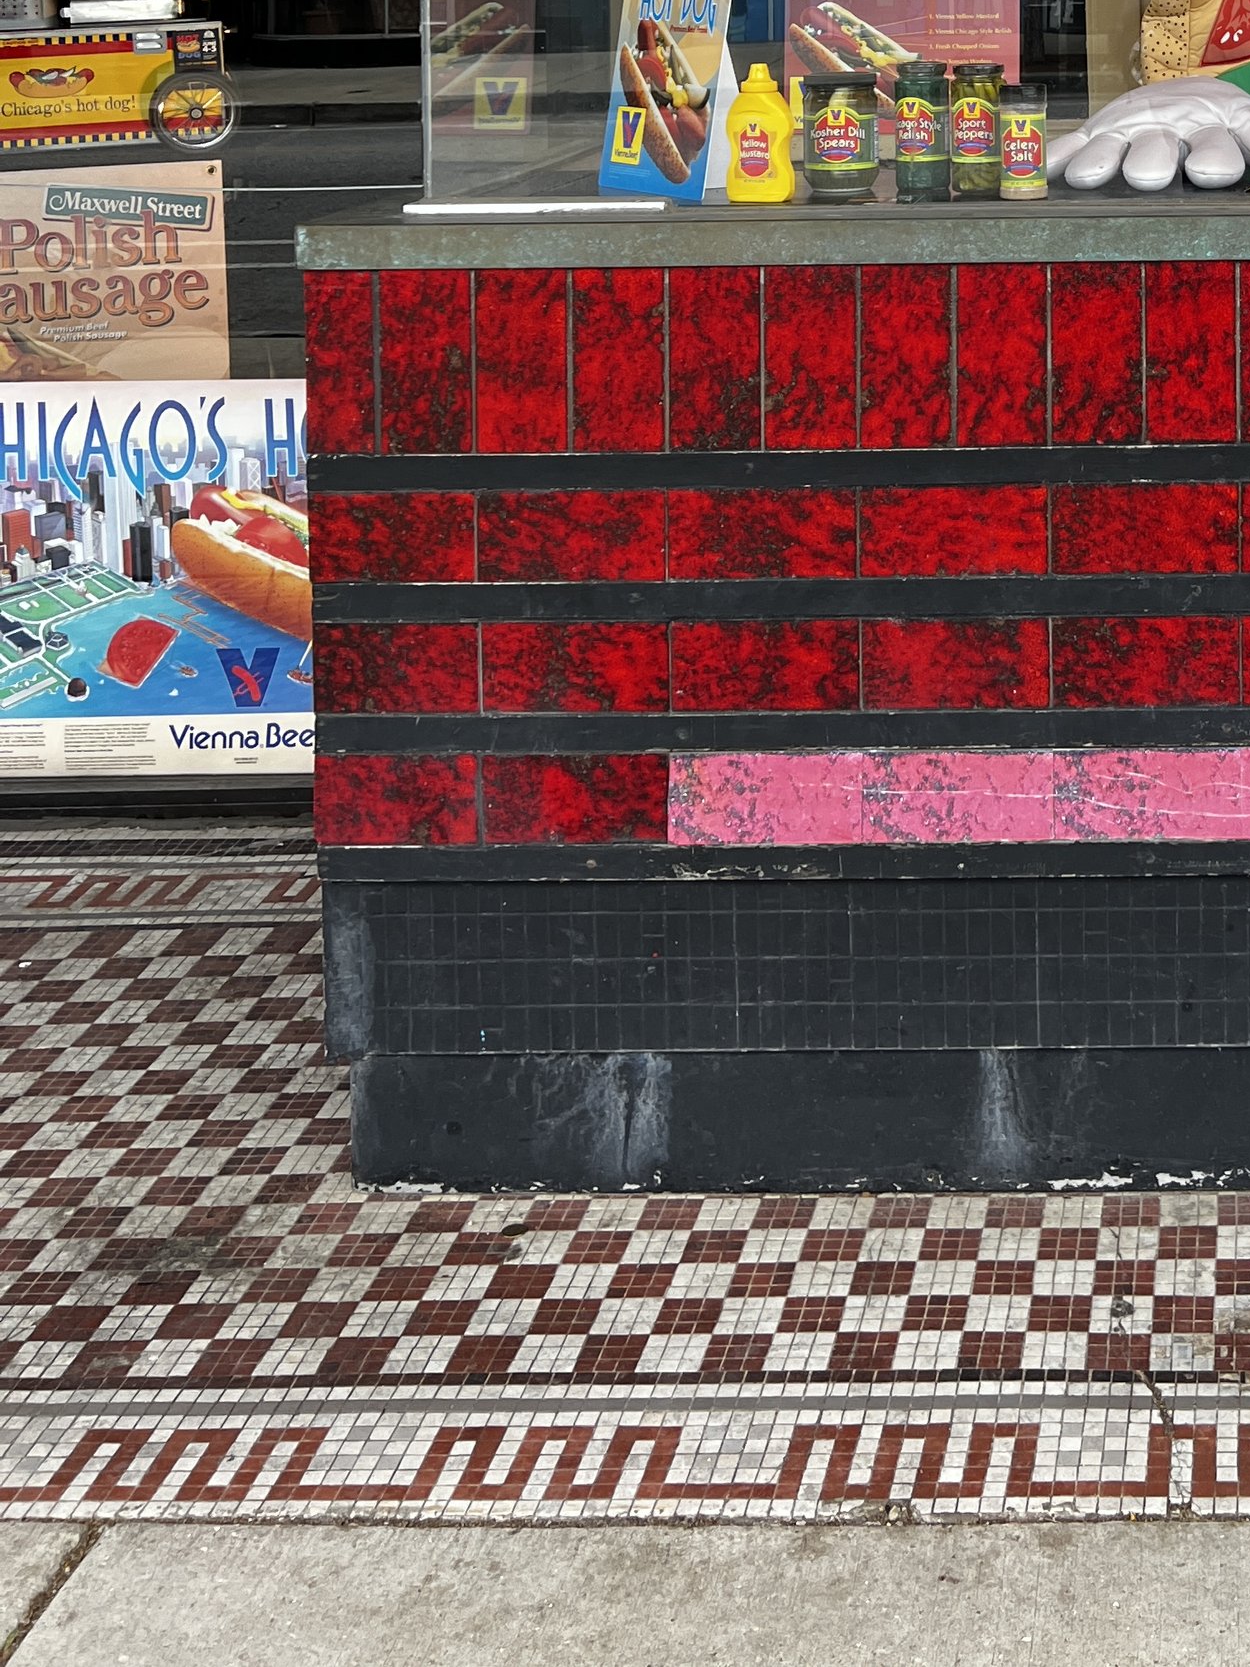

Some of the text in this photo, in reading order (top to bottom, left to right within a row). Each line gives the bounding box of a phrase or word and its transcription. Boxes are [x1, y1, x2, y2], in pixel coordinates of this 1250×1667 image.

[1, 95, 136, 118] Chicago's hot dog!
[919, 117, 942, 132] Style
[958, 118, 986, 131] Sport
[810, 126, 866, 140] Kosher Dill
[898, 130, 928, 140] Relish
[954, 128, 994, 141] Peppers
[742, 139, 767, 149] Yellow
[818, 138, 856, 150] Spears
[1004, 139, 1039, 153] Celery
[740, 150, 770, 160] Mustard
[1011, 151, 1033, 162] Salt
[49, 191, 203, 220] Maxwell Street
[0, 209, 182, 274] Polish
[0, 269, 210, 327] ausage
[40, 320, 110, 335] Premium Beef
[53, 330, 129, 343] Polish Sausage
[0, 396, 229, 501] HICAGO'S
[169, 723, 260, 750] Vienna
[265, 721, 316, 749] Bee
